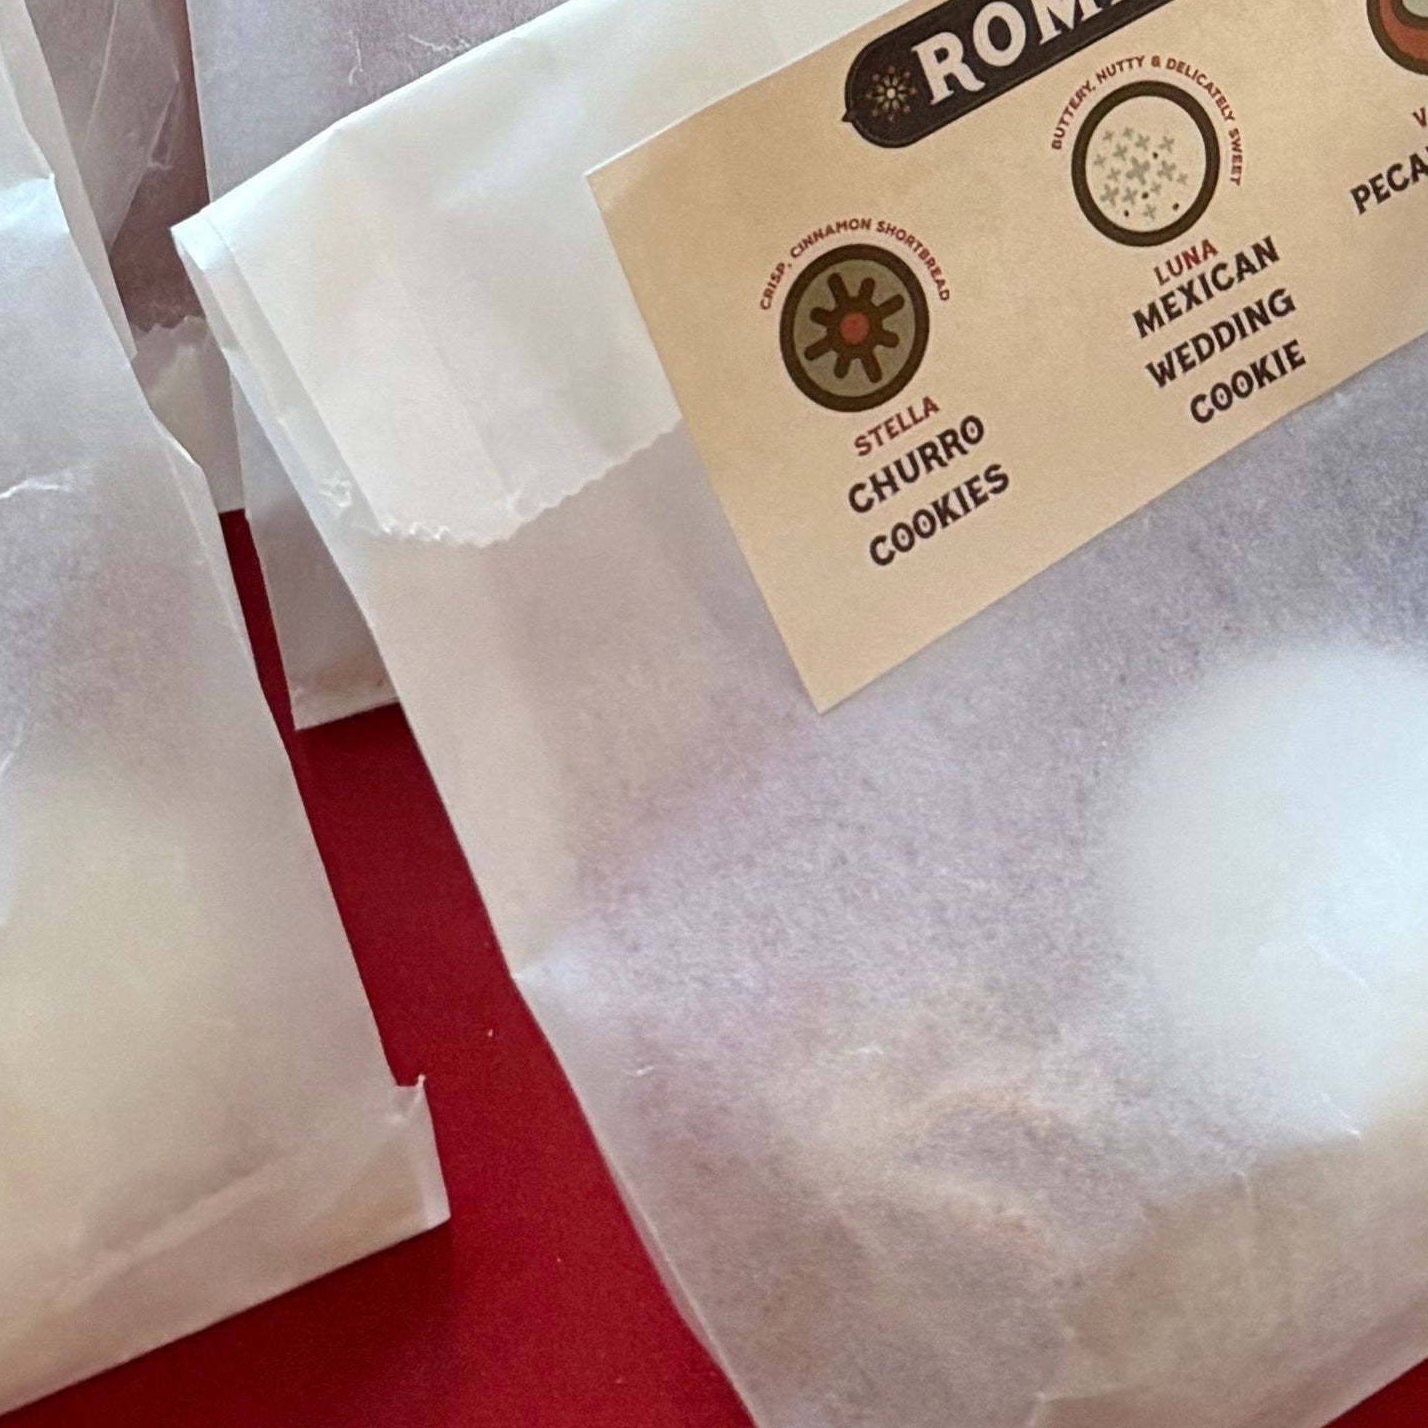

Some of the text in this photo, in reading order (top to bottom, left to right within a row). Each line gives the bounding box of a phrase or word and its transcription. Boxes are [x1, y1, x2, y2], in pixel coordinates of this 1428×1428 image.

[1095, 55, 1145, 84] NUTTY
[1166, 57, 1236, 121] DELICATELY
[1227, 128, 1243, 187] SWEET
[789, 217, 872, 259] CINNAMON
[876, 220, 951, 302] SHORTBREAD
[1133, 234, 1279, 340] MEXICAN
[1153, 238, 1219, 287] LUNA
[1145, 287, 1296, 389] WEDDING
[1190, 338, 1306, 424] COOKIE
[847, 416, 985, 512] CHURRO
[854, 396, 942, 457] STELLA
[868, 465, 1011, 564] COOKIES
